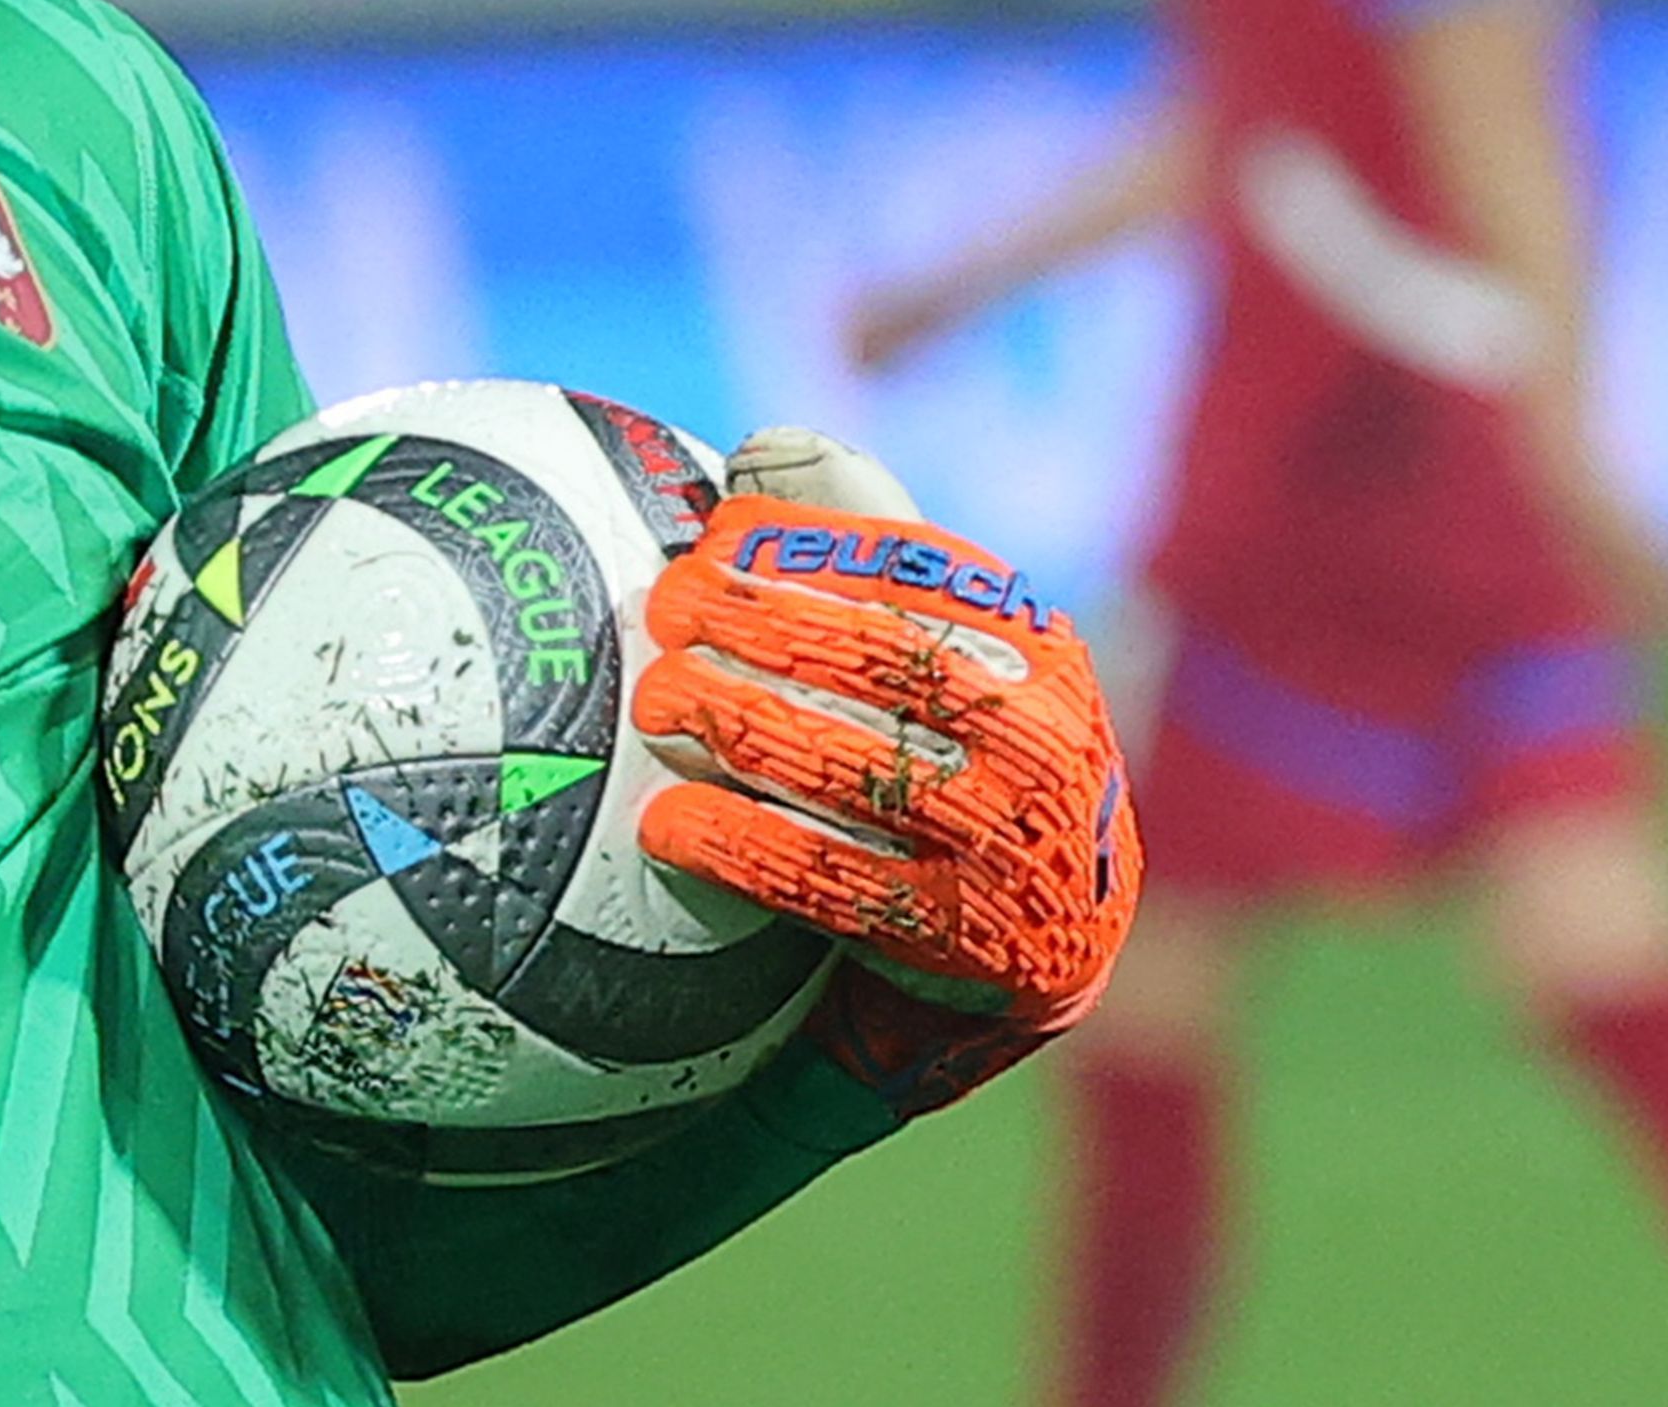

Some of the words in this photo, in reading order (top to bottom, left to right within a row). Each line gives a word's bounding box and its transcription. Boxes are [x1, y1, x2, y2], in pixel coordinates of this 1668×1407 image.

[410, 460, 591, 688] LEAGUE
[733, 524, 1054, 633] reusch
[103, 639, 200, 807] IONS
